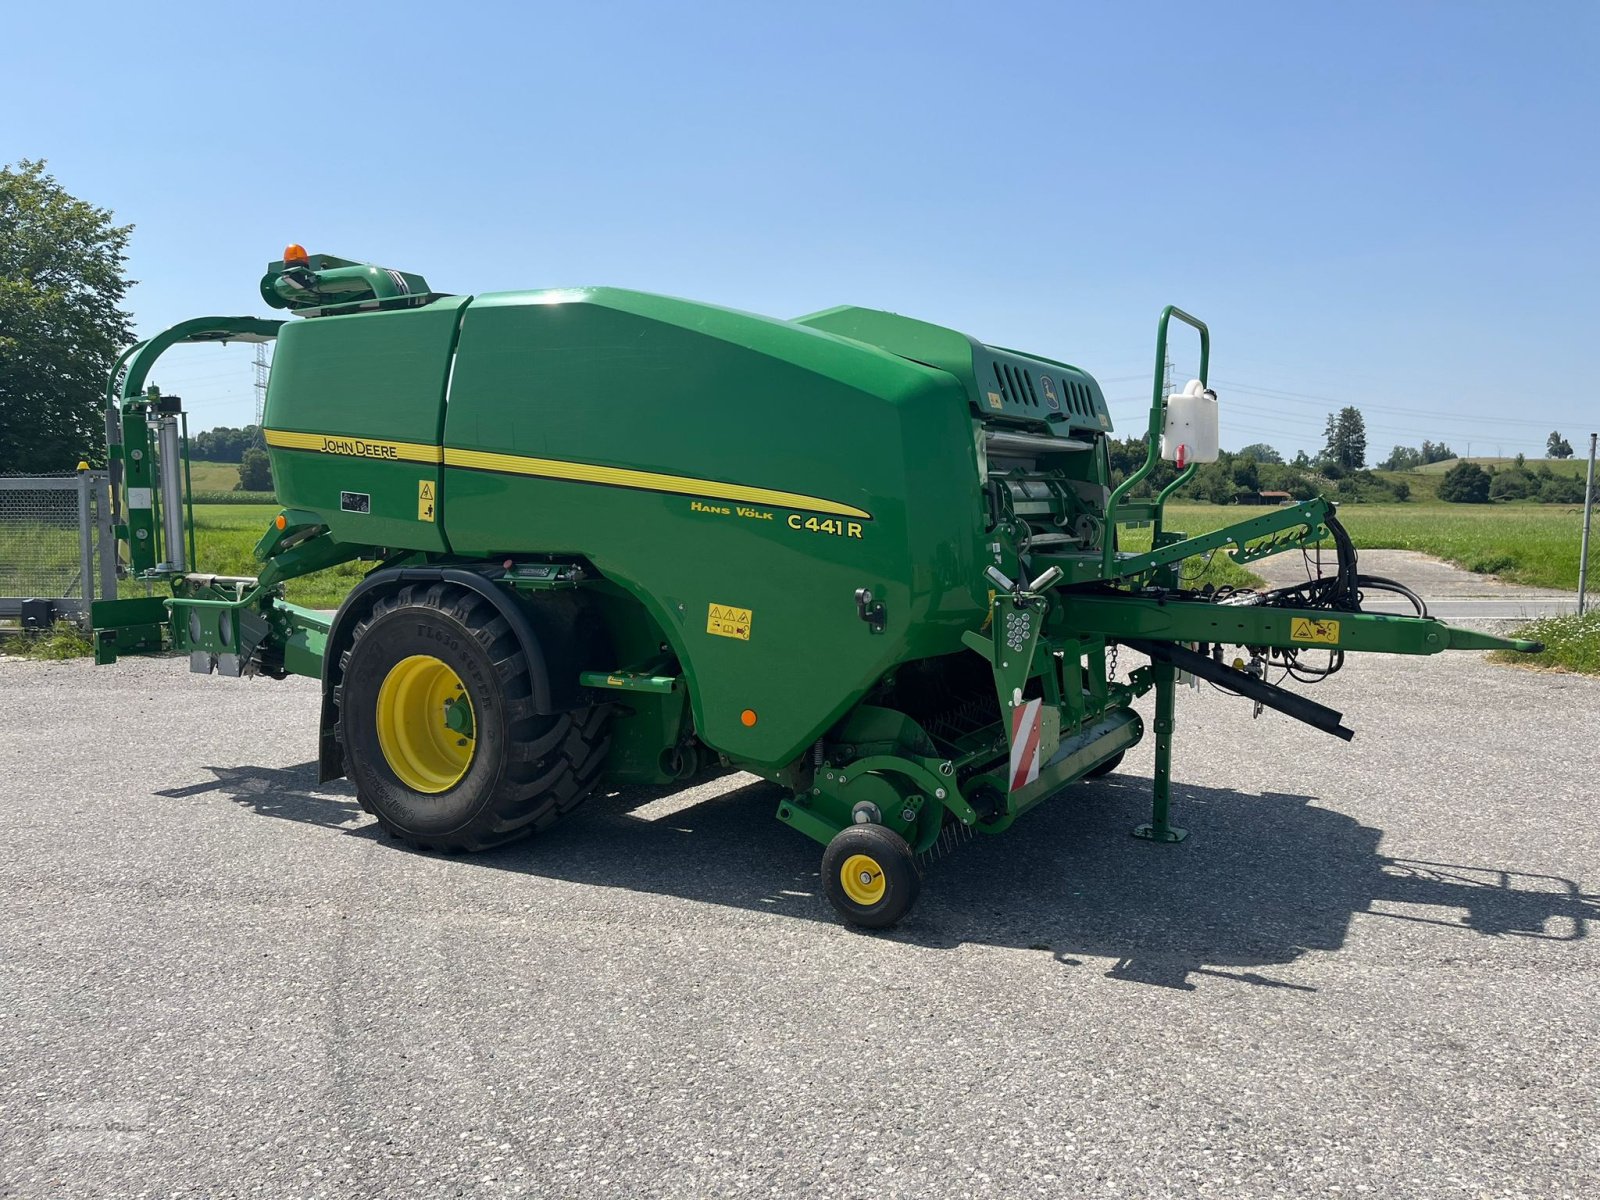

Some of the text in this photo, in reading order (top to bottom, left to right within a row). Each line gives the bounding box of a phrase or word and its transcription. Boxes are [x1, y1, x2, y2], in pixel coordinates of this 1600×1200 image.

[321, 438, 398, 458] JOHN DEERE
[690, 501, 774, 520] HANS VÖLK
